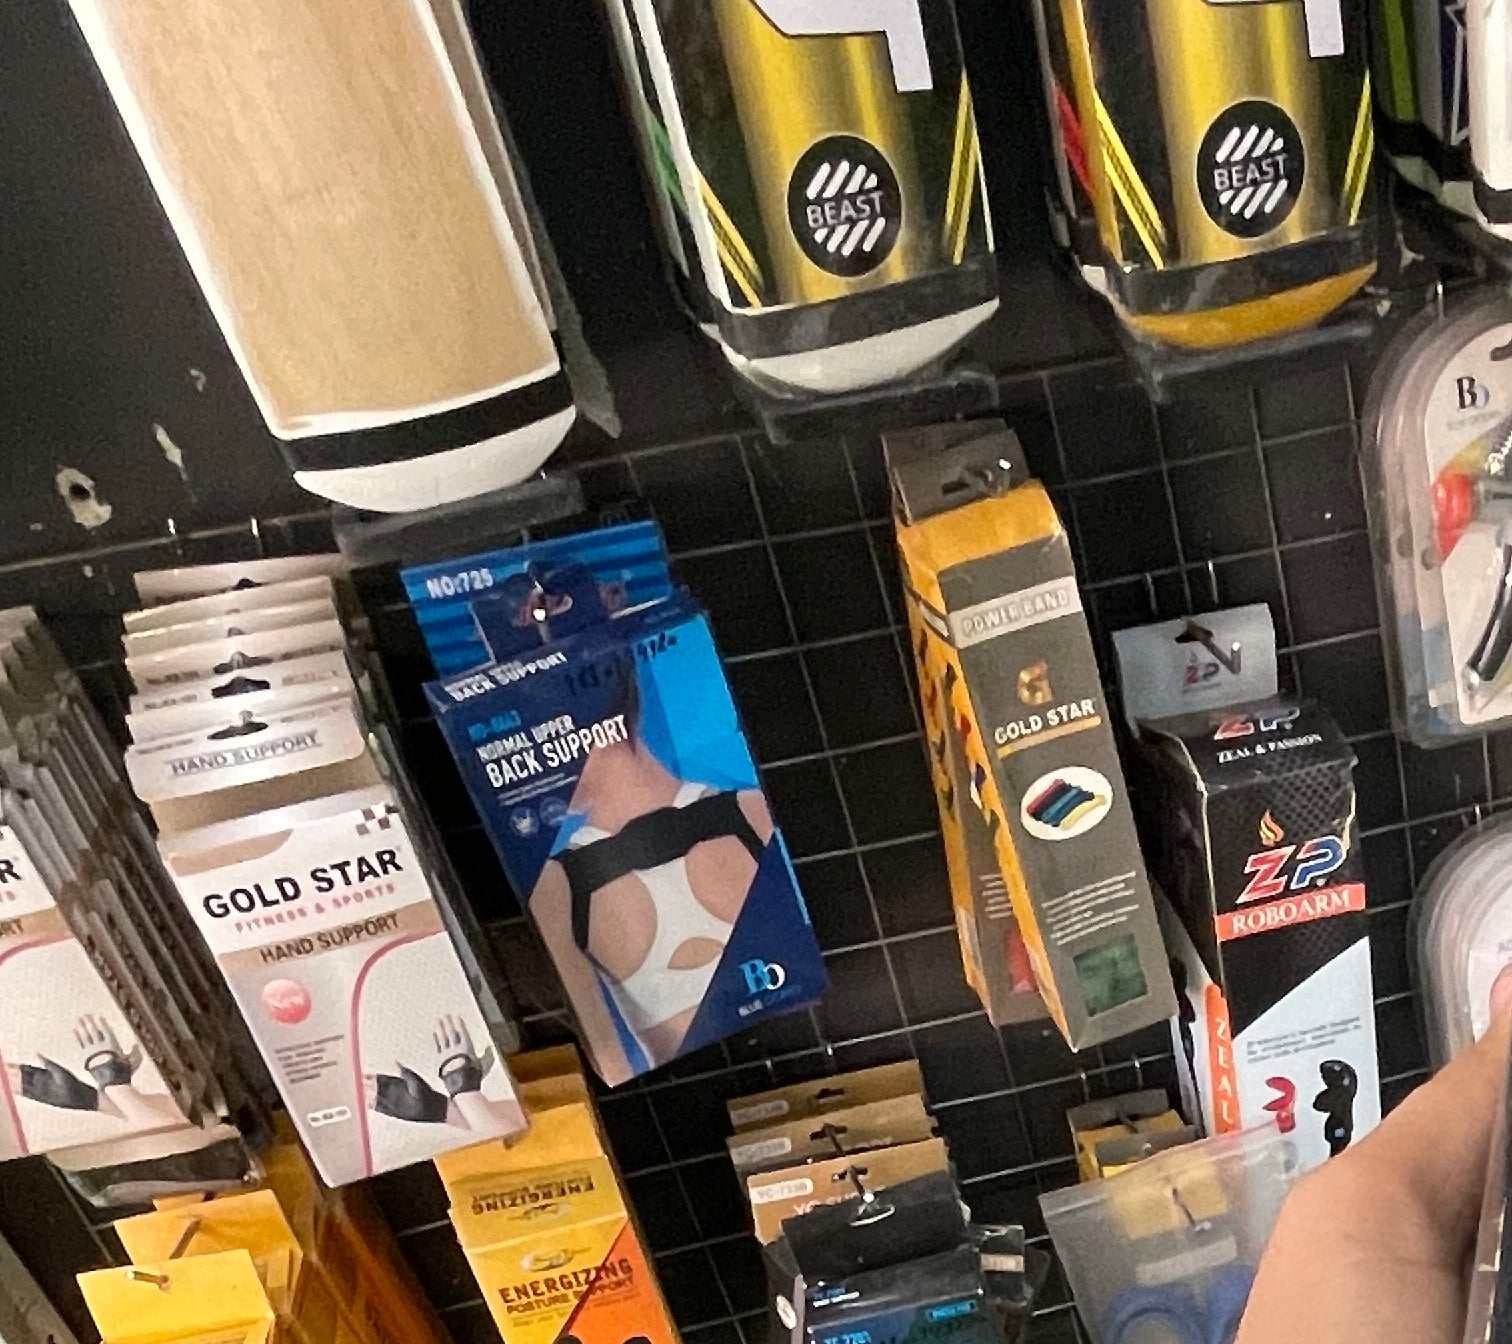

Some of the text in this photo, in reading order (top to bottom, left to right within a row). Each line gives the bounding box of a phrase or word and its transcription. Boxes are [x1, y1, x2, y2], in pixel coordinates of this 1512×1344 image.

[1214, 152, 1290, 190] BEAST
[806, 190, 886, 230] BEAST
[994, 698, 1097, 745] GOLD STAR
[485, 751, 544, 788] BACK
[543, 714, 631, 769] SUPPORT
[202, 848, 403, 919] GOLD STAR
[332, 882, 396, 908] SPORTS
[1231, 888, 1351, 935] ROBOARM
[261, 912, 400, 964] HAND SUPPORT
